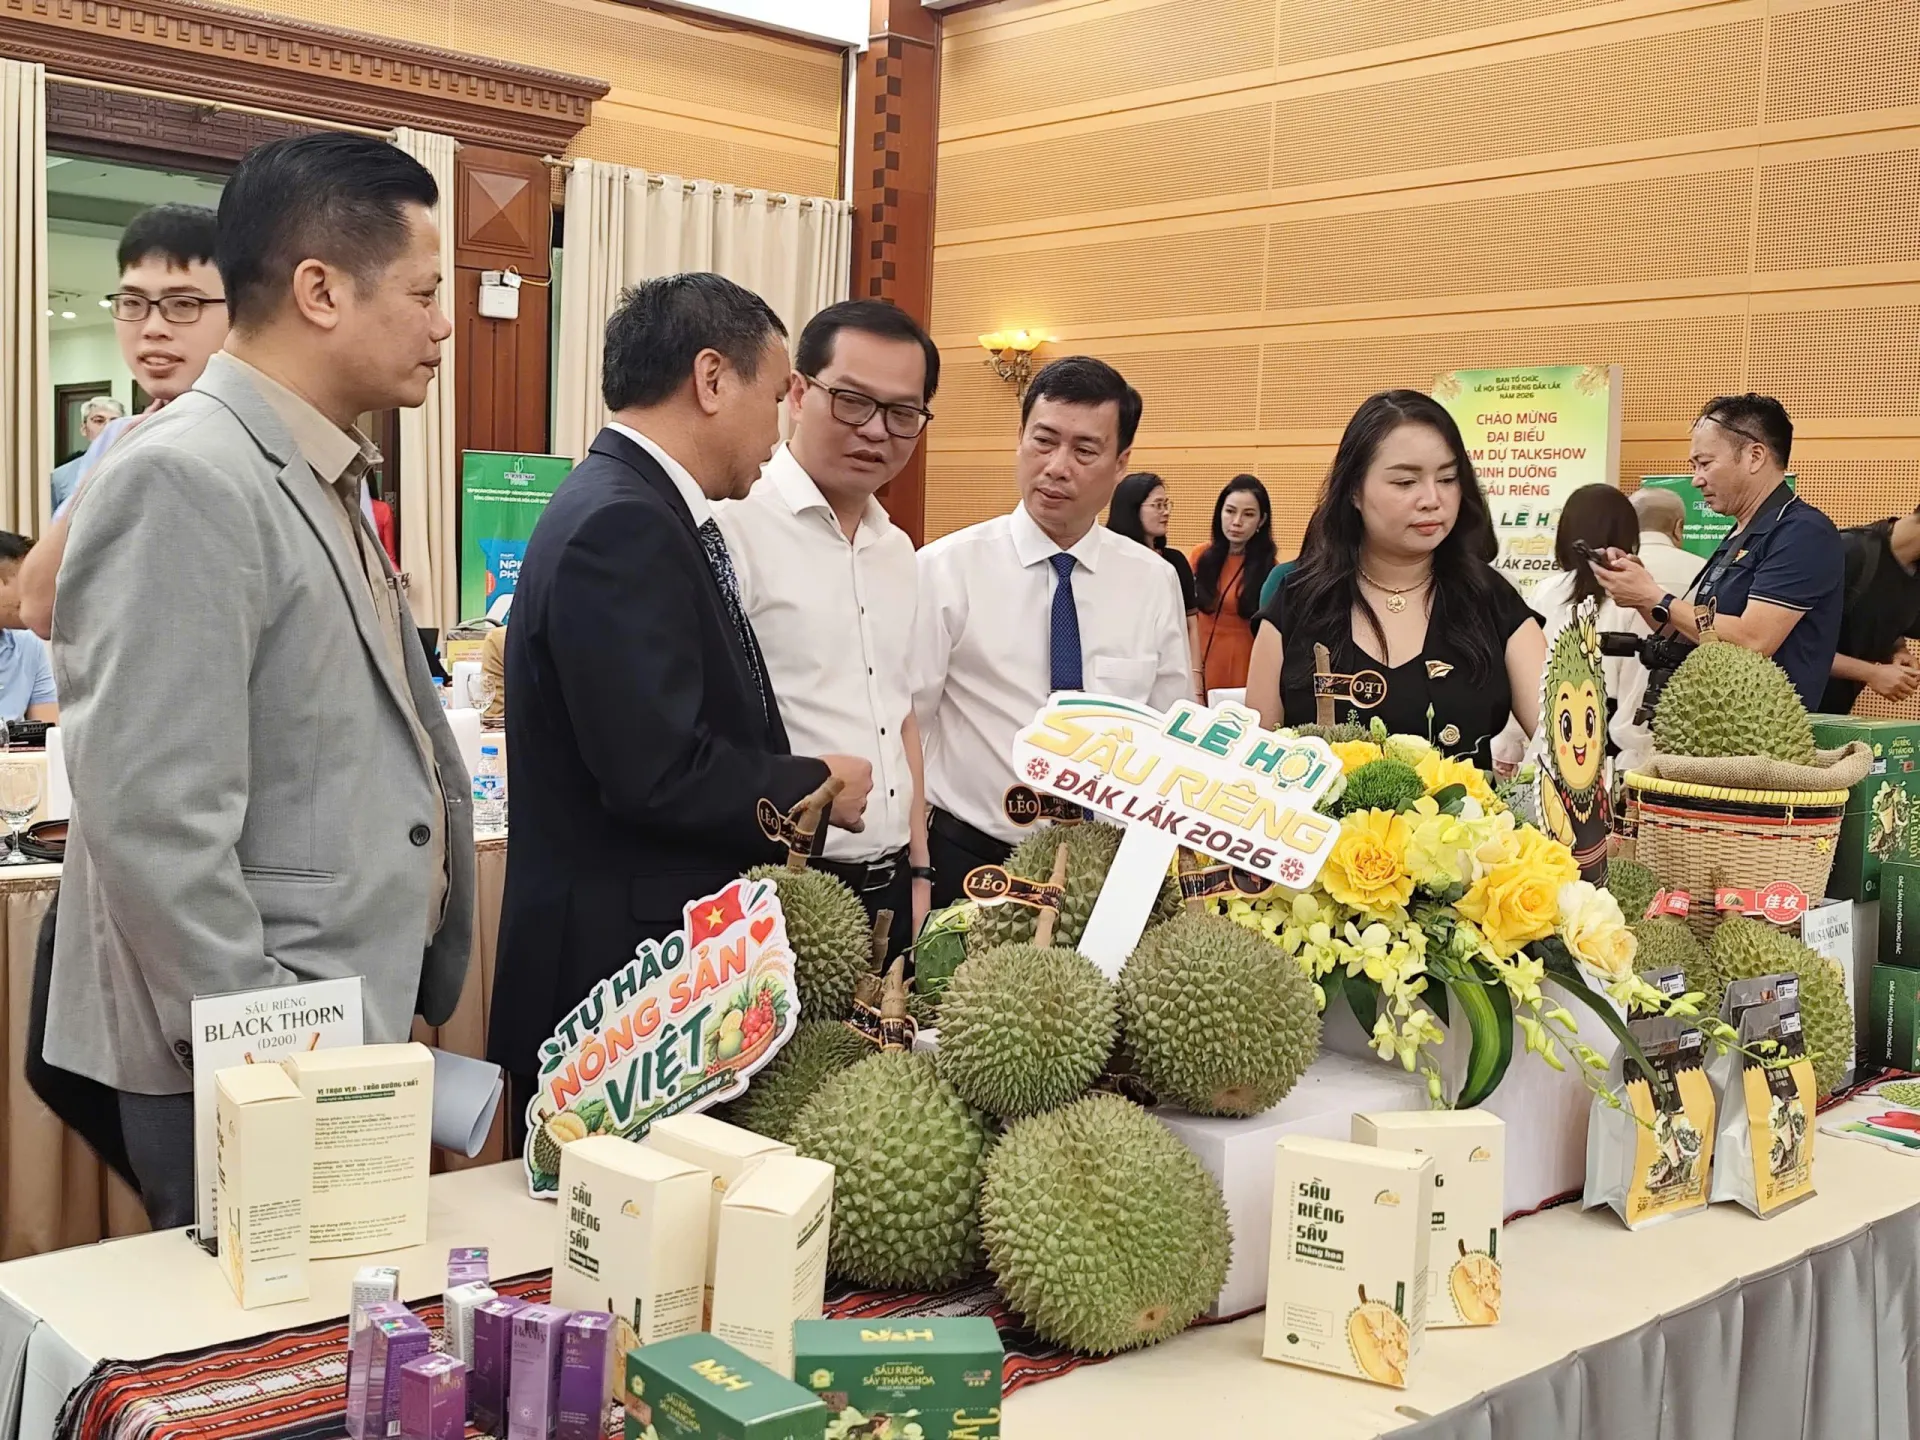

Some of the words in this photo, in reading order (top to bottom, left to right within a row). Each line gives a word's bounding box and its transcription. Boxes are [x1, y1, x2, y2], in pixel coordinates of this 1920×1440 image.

[1516, 391, 1535, 399] 2026
[1476, 411, 1512, 425] CHÀO
[1516, 410, 1558, 424] MỪNG
[1487, 431, 1510, 445] ĐẠI
[1514, 426, 1545, 442] BIỂU
[1466, 449, 1484, 461] AM
[1488, 448, 1508, 464] DỰ
[1511, 448, 1586, 460] TALKSHOW
[1508, 463, 1557, 478] DƯỠNG
[1509, 481, 1550, 496] RIÊNG
[1523, 559, 1560, 571] 2026
[1353, 680, 1383, 694] LEO
[1166, 710, 1250, 758] LỄ
[1245, 741, 1328, 790] HỘI
[1024, 711, 1161, 786] SẦU
[1158, 778, 1330, 854] RIÊNG
[1008, 800, 1038, 814] LEO
[760, 808, 779, 830] LEO
[1052, 768, 1123, 810] ĐẮK
[1122, 797, 1187, 835] LẮK
[1185, 821, 1279, 870] 2026
[969, 877, 1006, 892] LEO
[1765, 893, 1800, 910] 佳农
[558, 984, 605, 1048] TỰ
[612, 935, 684, 1007] HÀO
[245, 1001, 269, 1016] SẦU
[272, 996, 307, 1012] RIÊNG
[204, 1014, 274, 1043] BLACK
[278, 1004, 344, 1031] THORN
[550, 996, 661, 1111] NÔNG
[669, 936, 746, 1014] SẢN
[257, 1033, 297, 1051] (D200)
[605, 1003, 714, 1124] VIỆT
[572, 1181, 592, 1208] SẦU
[1298, 1177, 1331, 1202] SẦU
[570, 1206, 600, 1233] RIÊNG
[1297, 1201, 1345, 1225] RIÊNG
[569, 1228, 589, 1251] SẤY
[1296, 1221, 1328, 1243] SẤY
[1297, 1242, 1324, 1259] thăng
[1324, 1249, 1343, 1261] hoa
[895, 1364, 924, 1376] RIÊNG
[914, 1376, 936, 1387] HOA
